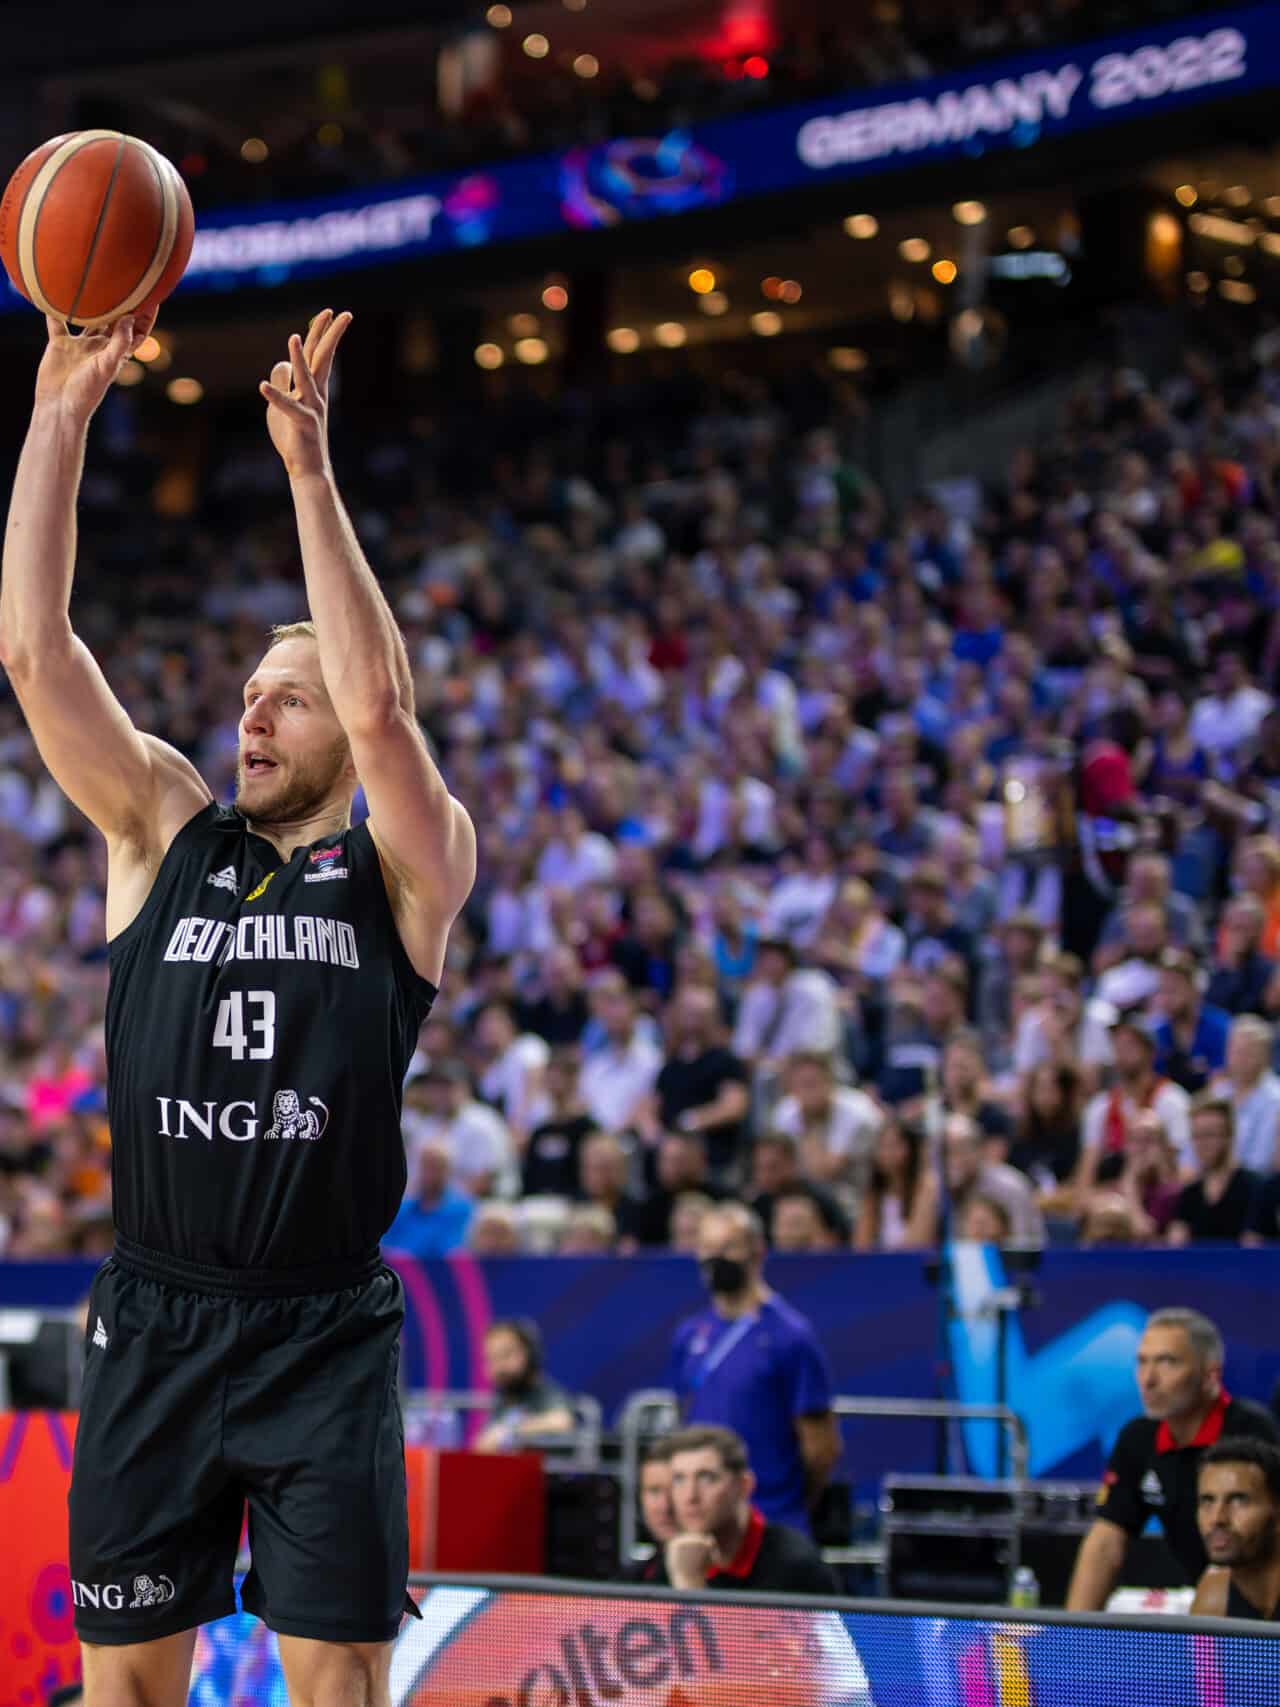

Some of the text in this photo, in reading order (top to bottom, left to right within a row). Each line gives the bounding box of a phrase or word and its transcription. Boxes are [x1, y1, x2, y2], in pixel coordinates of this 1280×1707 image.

[798, 28, 1247, 168] GERMANY 2022
[213, 990, 277, 1061] 43
[156, 1096, 260, 1142] ING
[71, 1579, 125, 1611] ING
[486, 1604, 724, 1707] olten
